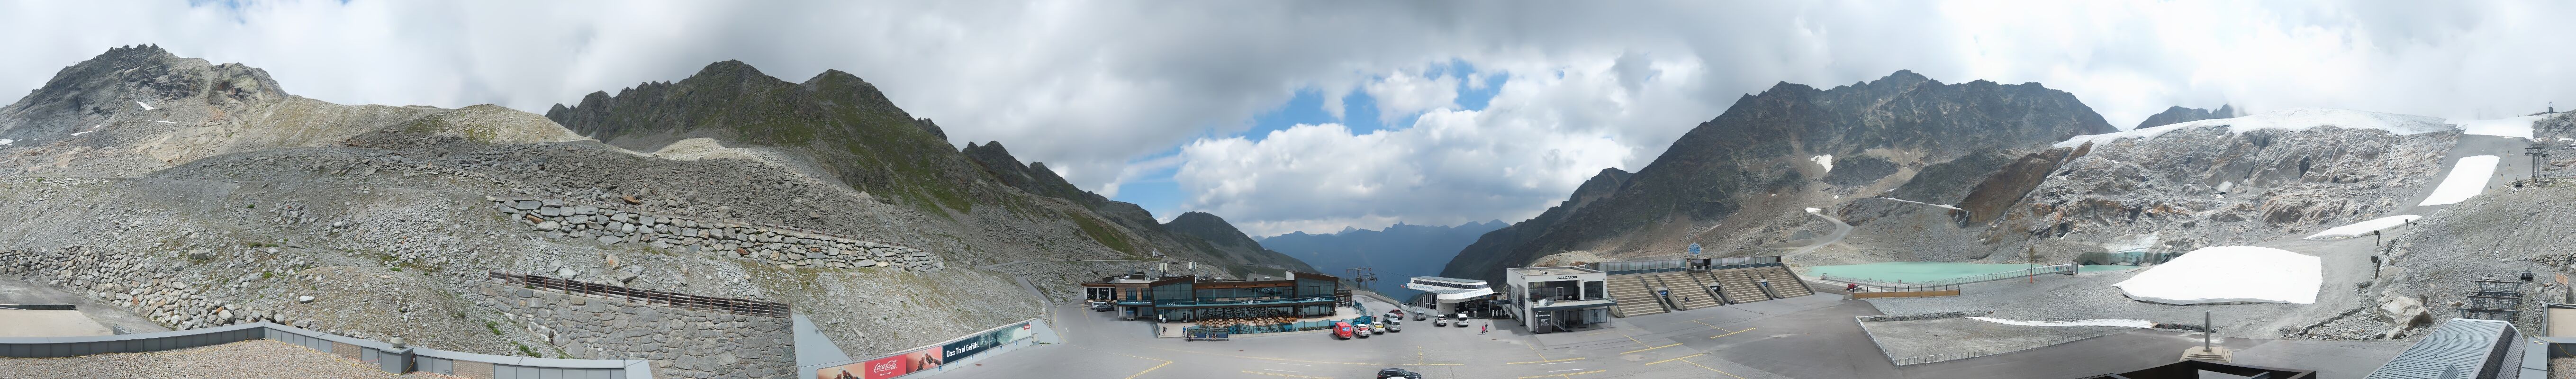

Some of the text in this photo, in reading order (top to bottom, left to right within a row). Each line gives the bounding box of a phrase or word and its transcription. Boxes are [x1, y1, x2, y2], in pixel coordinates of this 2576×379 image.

[956, 345, 966, 355] Tirol
[966, 341, 979, 352] Gefühl
[874, 360, 898, 373] Coca-Cola
